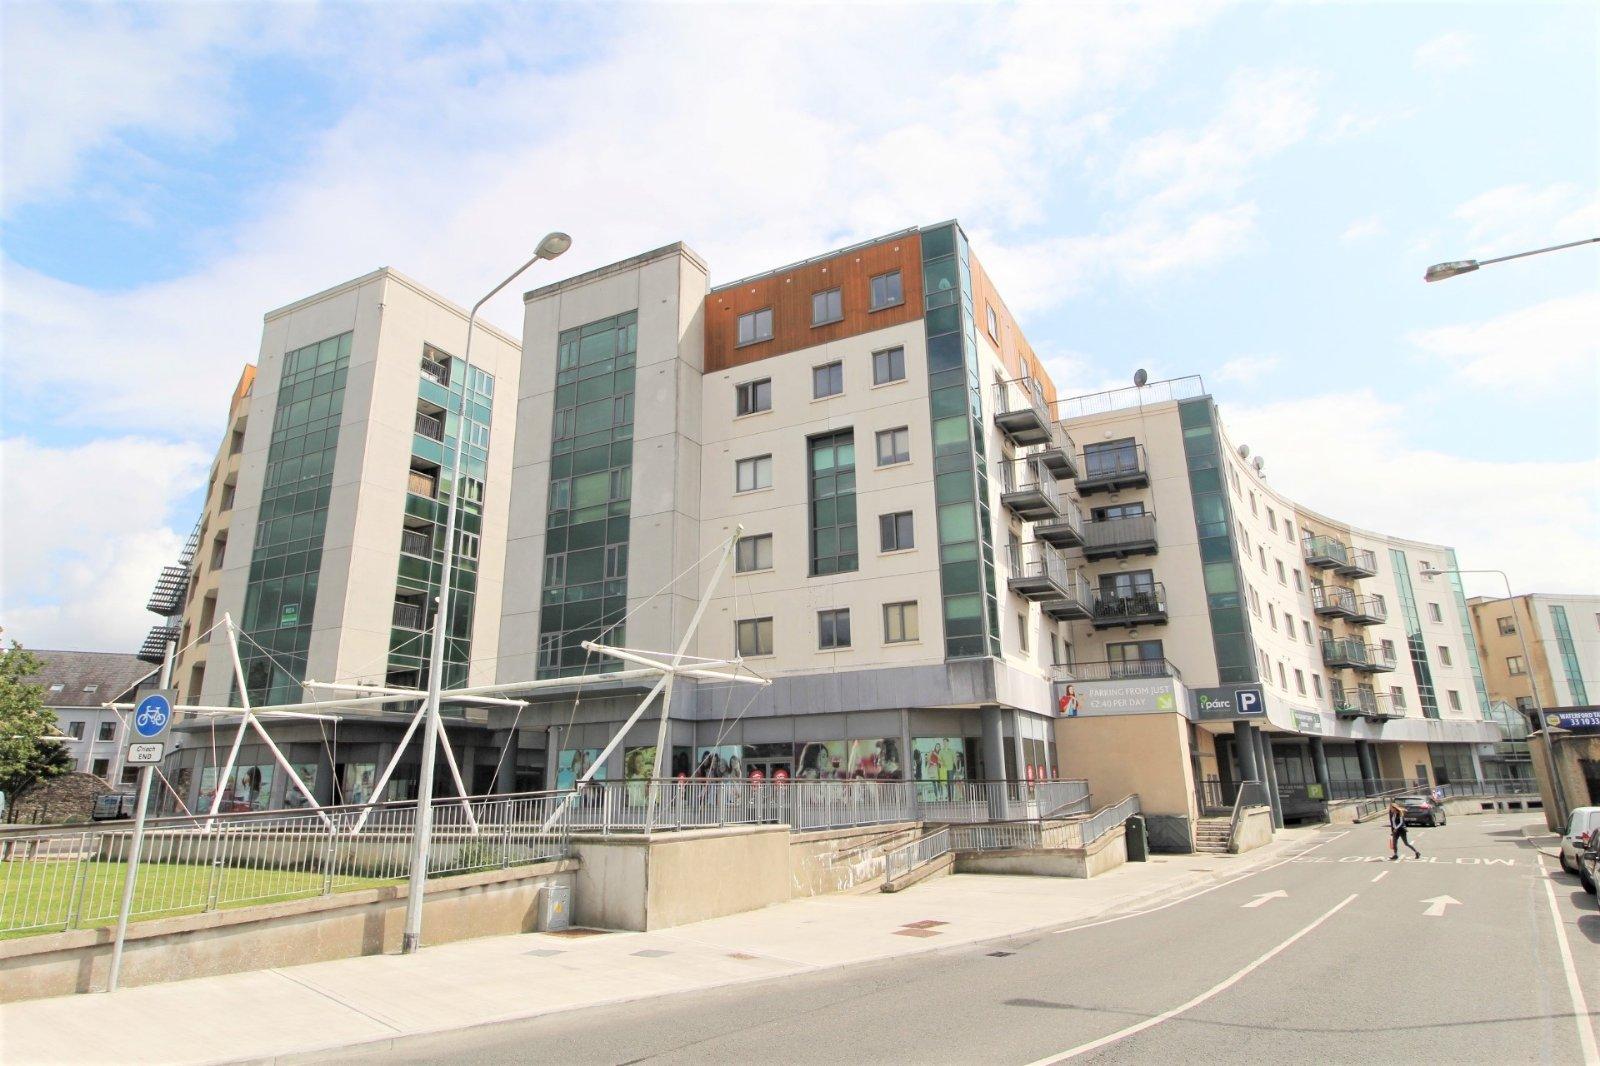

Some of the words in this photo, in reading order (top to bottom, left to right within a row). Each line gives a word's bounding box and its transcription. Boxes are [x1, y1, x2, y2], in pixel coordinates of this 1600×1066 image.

[1089, 687, 1124, 697] PARKING
[1125, 687, 1149, 696] FROM
[1151, 685, 1169, 695] JUST
[1113, 698, 1128, 707] PER
[1129, 697, 1146, 706] DAY
[1241, 693, 1256, 711] P
